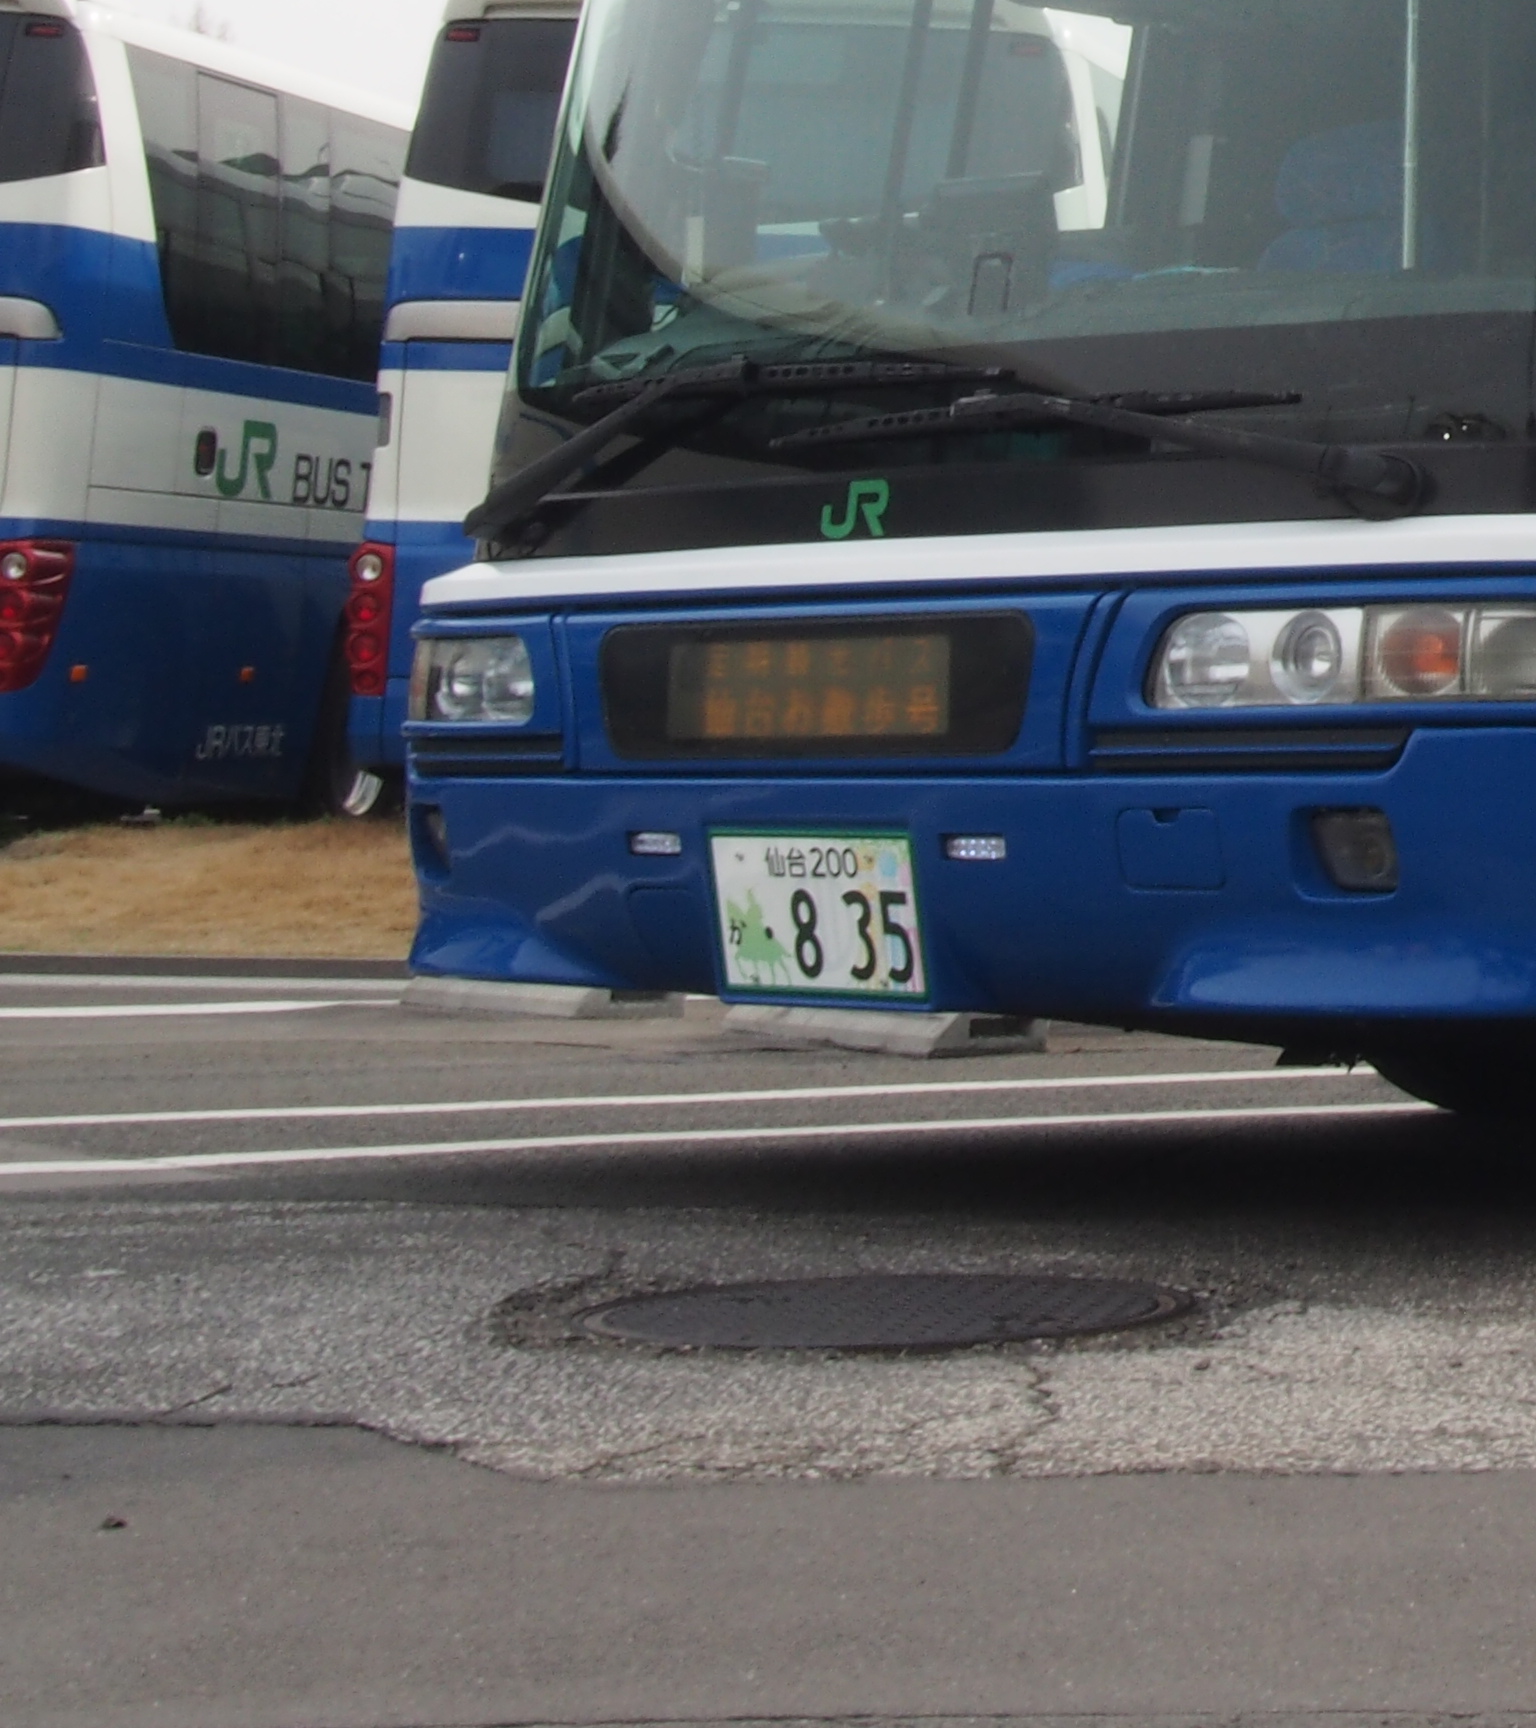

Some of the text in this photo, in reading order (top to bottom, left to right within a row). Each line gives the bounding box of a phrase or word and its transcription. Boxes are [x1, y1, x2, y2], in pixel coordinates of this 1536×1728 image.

[215, 420, 278, 499] JR
[292, 452, 352, 508] BUS
[820, 478, 889, 539] JR
